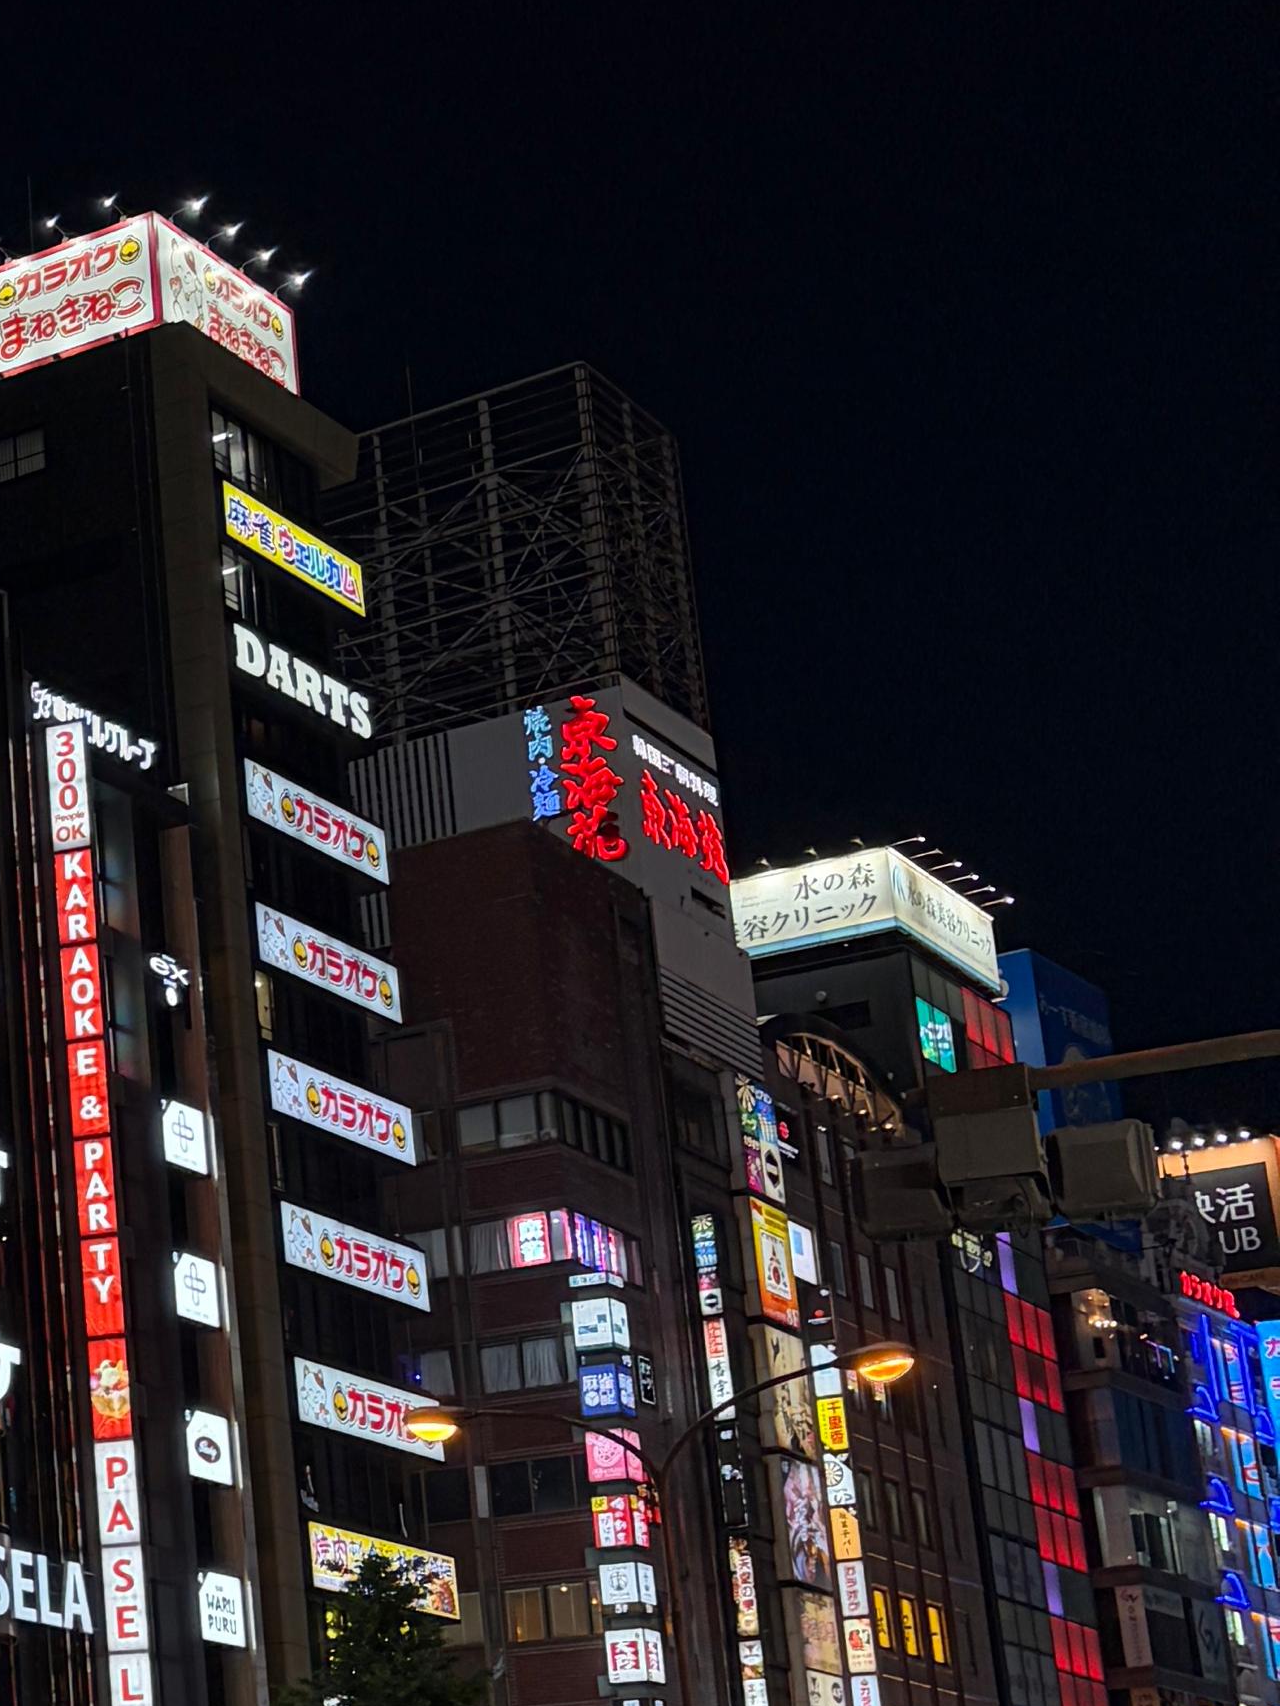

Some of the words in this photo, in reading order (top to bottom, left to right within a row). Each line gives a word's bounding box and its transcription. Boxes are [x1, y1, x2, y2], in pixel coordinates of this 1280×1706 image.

[17, 240, 117, 298] カラオケ
[217, 272, 272, 330] カラオケ
[207, 301, 289, 383] まねきねこ
[233, 623, 372, 740] DARTS
[55, 730, 77, 812] 300
[55, 823, 87, 844] OK
[290, 795, 366, 861] カラオケ
[793, 863, 875, 902] 水の森
[907, 880, 992, 955] 水の森美容クリニック
[63, 852, 100, 1077] KARAOKE
[307, 940, 381, 1000] カラオケ
[79, 1094, 103, 1120] &
[319, 1085, 395, 1145] カラオケ
[85, 1143, 115, 1305] PARTY
[1218, 1226, 1262, 1255] UB
[333, 1238, 408, 1296] カラオケ
